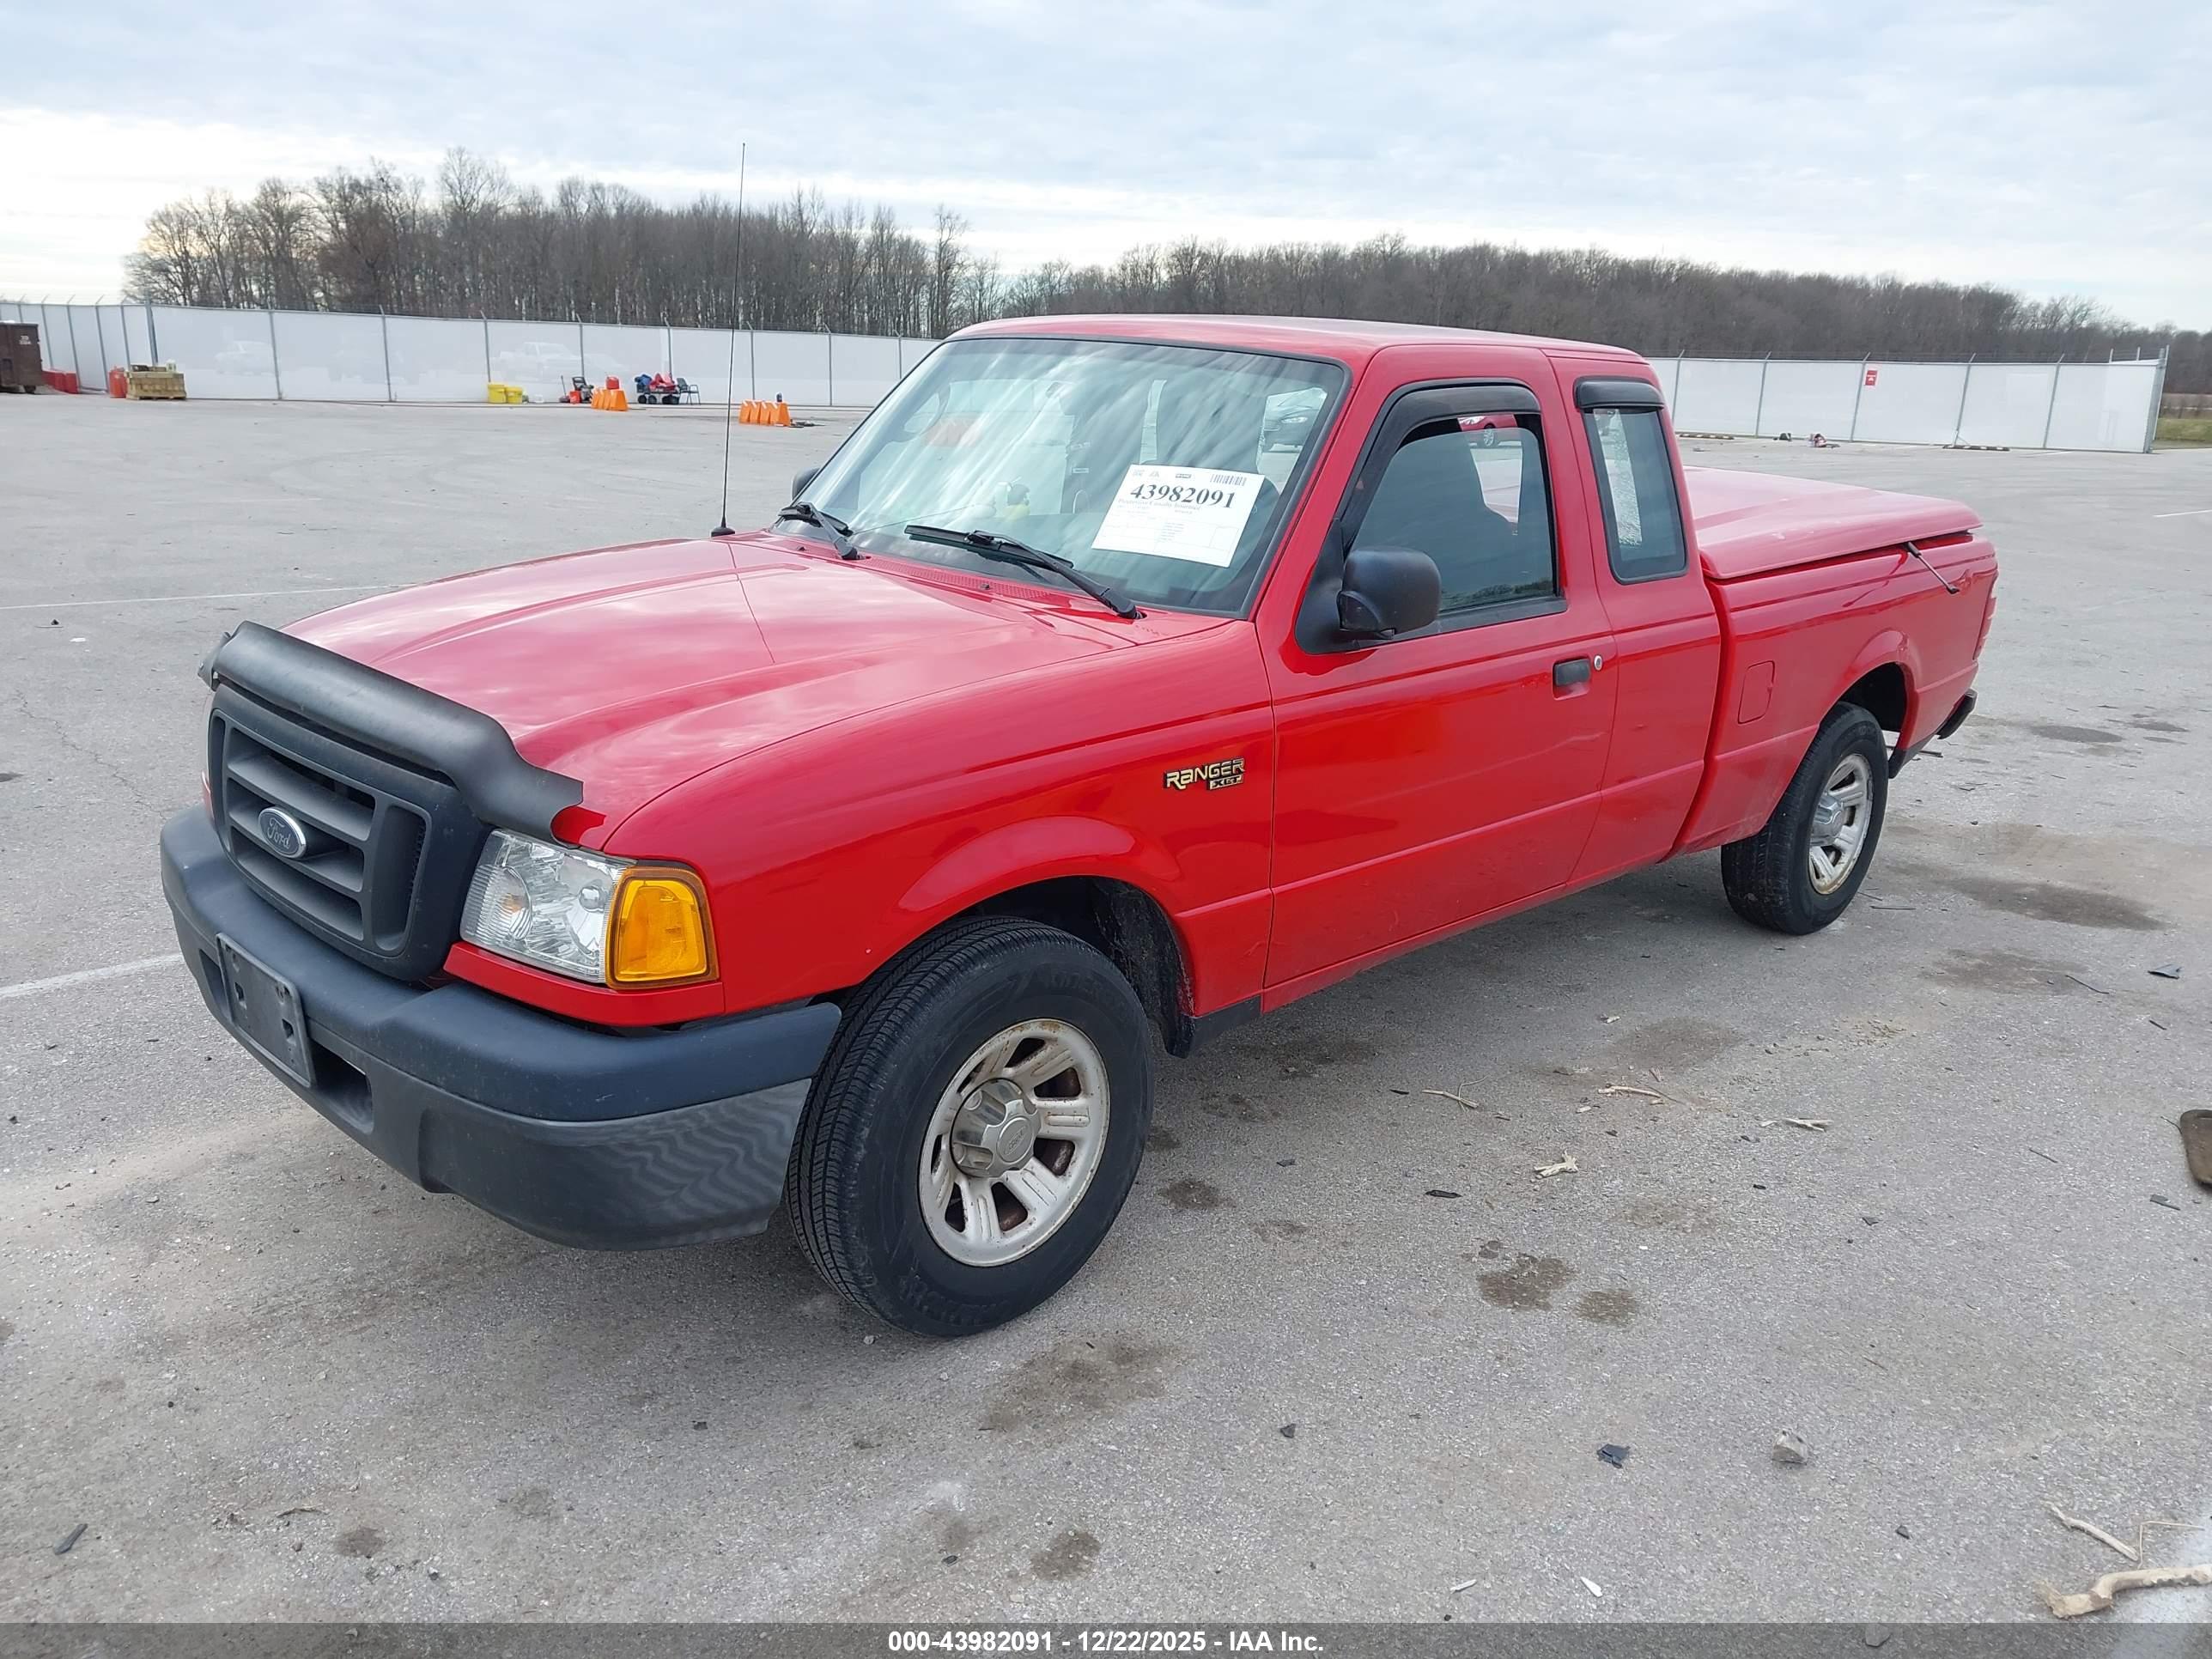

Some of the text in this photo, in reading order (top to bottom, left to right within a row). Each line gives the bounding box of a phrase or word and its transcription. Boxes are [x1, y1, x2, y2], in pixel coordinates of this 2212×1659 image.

[1130, 483, 1236, 508] 43982091
[1166, 758, 1245, 789] RANGER
[267, 817, 291, 850] Ford
